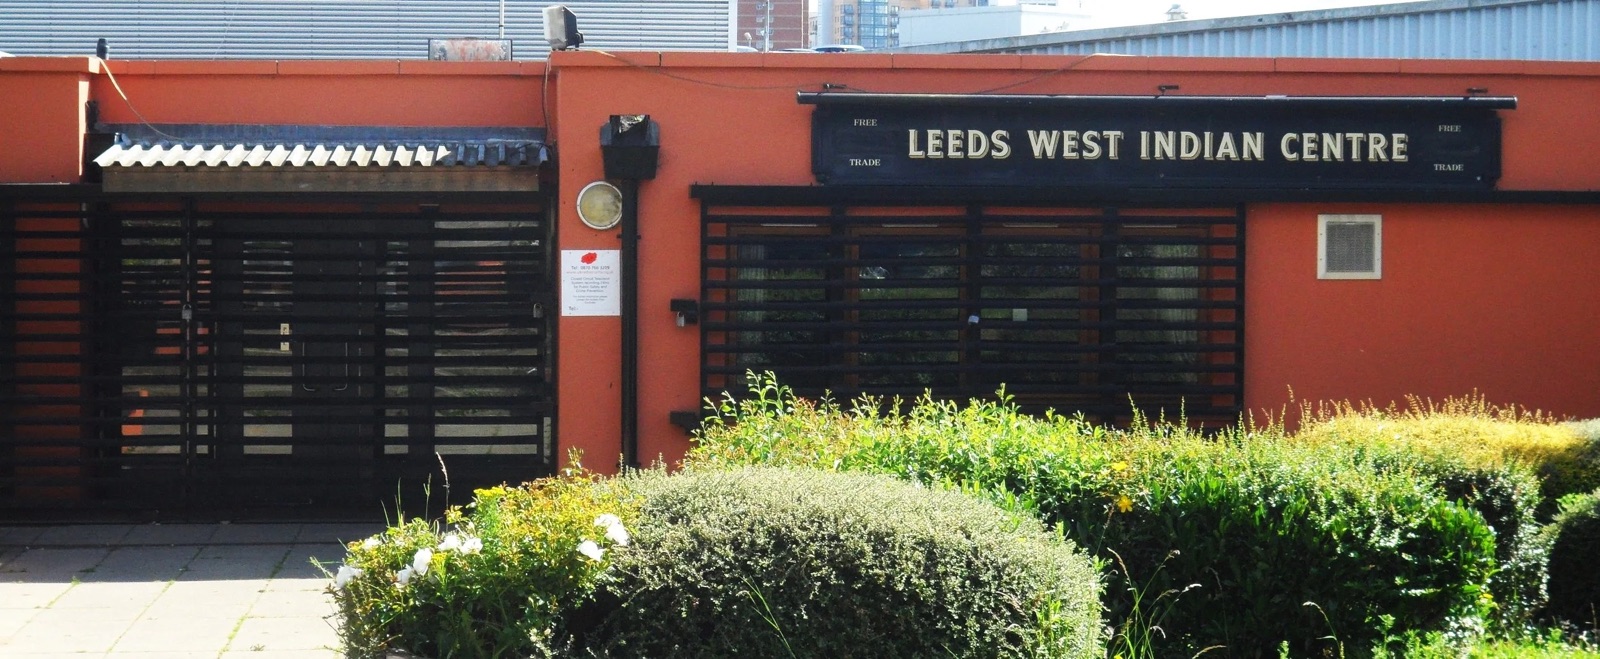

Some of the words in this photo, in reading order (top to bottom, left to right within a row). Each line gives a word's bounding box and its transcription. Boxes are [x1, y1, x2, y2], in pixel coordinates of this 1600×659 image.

[853, 118, 878, 127] FREE
[1438, 124, 1462, 133] FREE
[908, 129, 1010, 159] LEEDS
[1027, 130, 1125, 160] WEST
[1140, 131, 1265, 161] INDIAN
[1281, 132, 1409, 162] CENTRE
[849, 158, 881, 167] TRADE
[1433, 163, 1464, 172] TRADE
